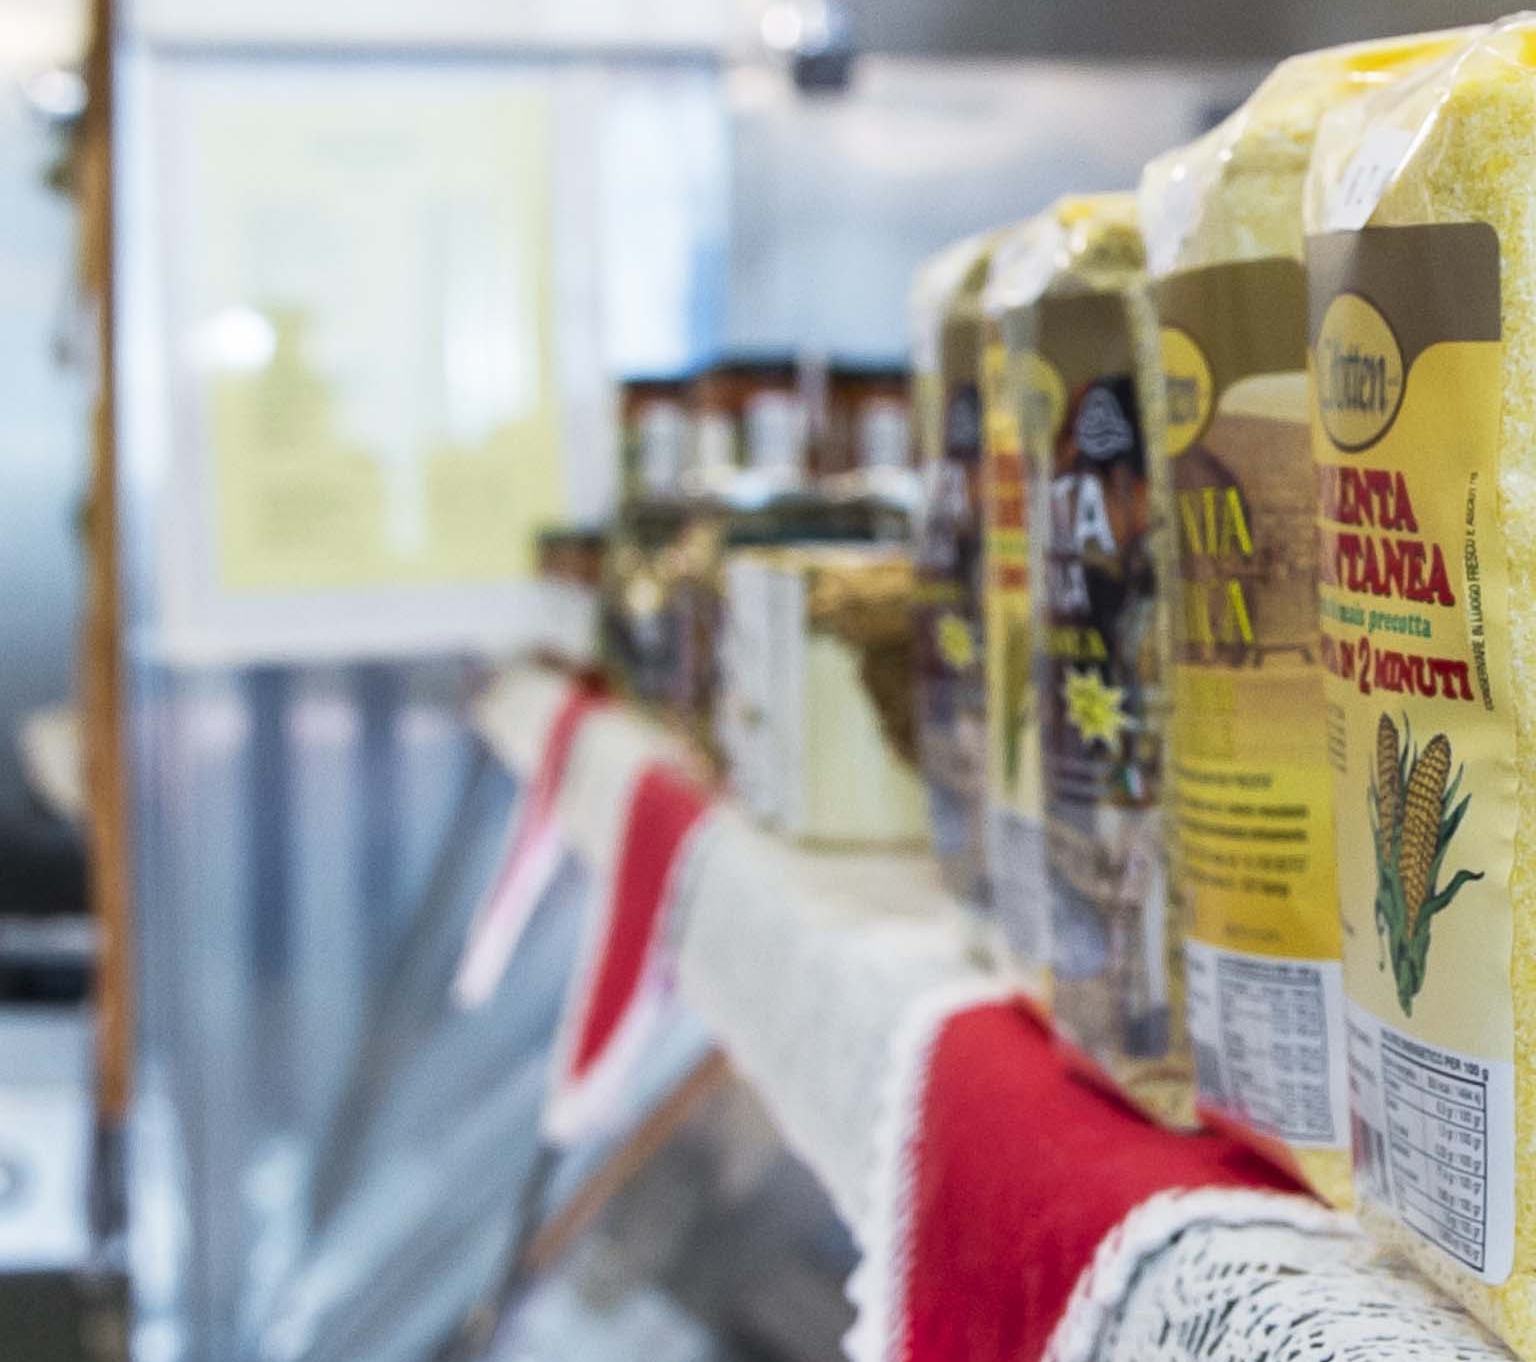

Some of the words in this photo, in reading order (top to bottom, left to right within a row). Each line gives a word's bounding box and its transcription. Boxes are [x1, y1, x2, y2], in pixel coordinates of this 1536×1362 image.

[1467, 583, 1485, 624] LUOGO
[1357, 636, 1371, 696] 2
[1374, 648, 1475, 702] MINUTI
